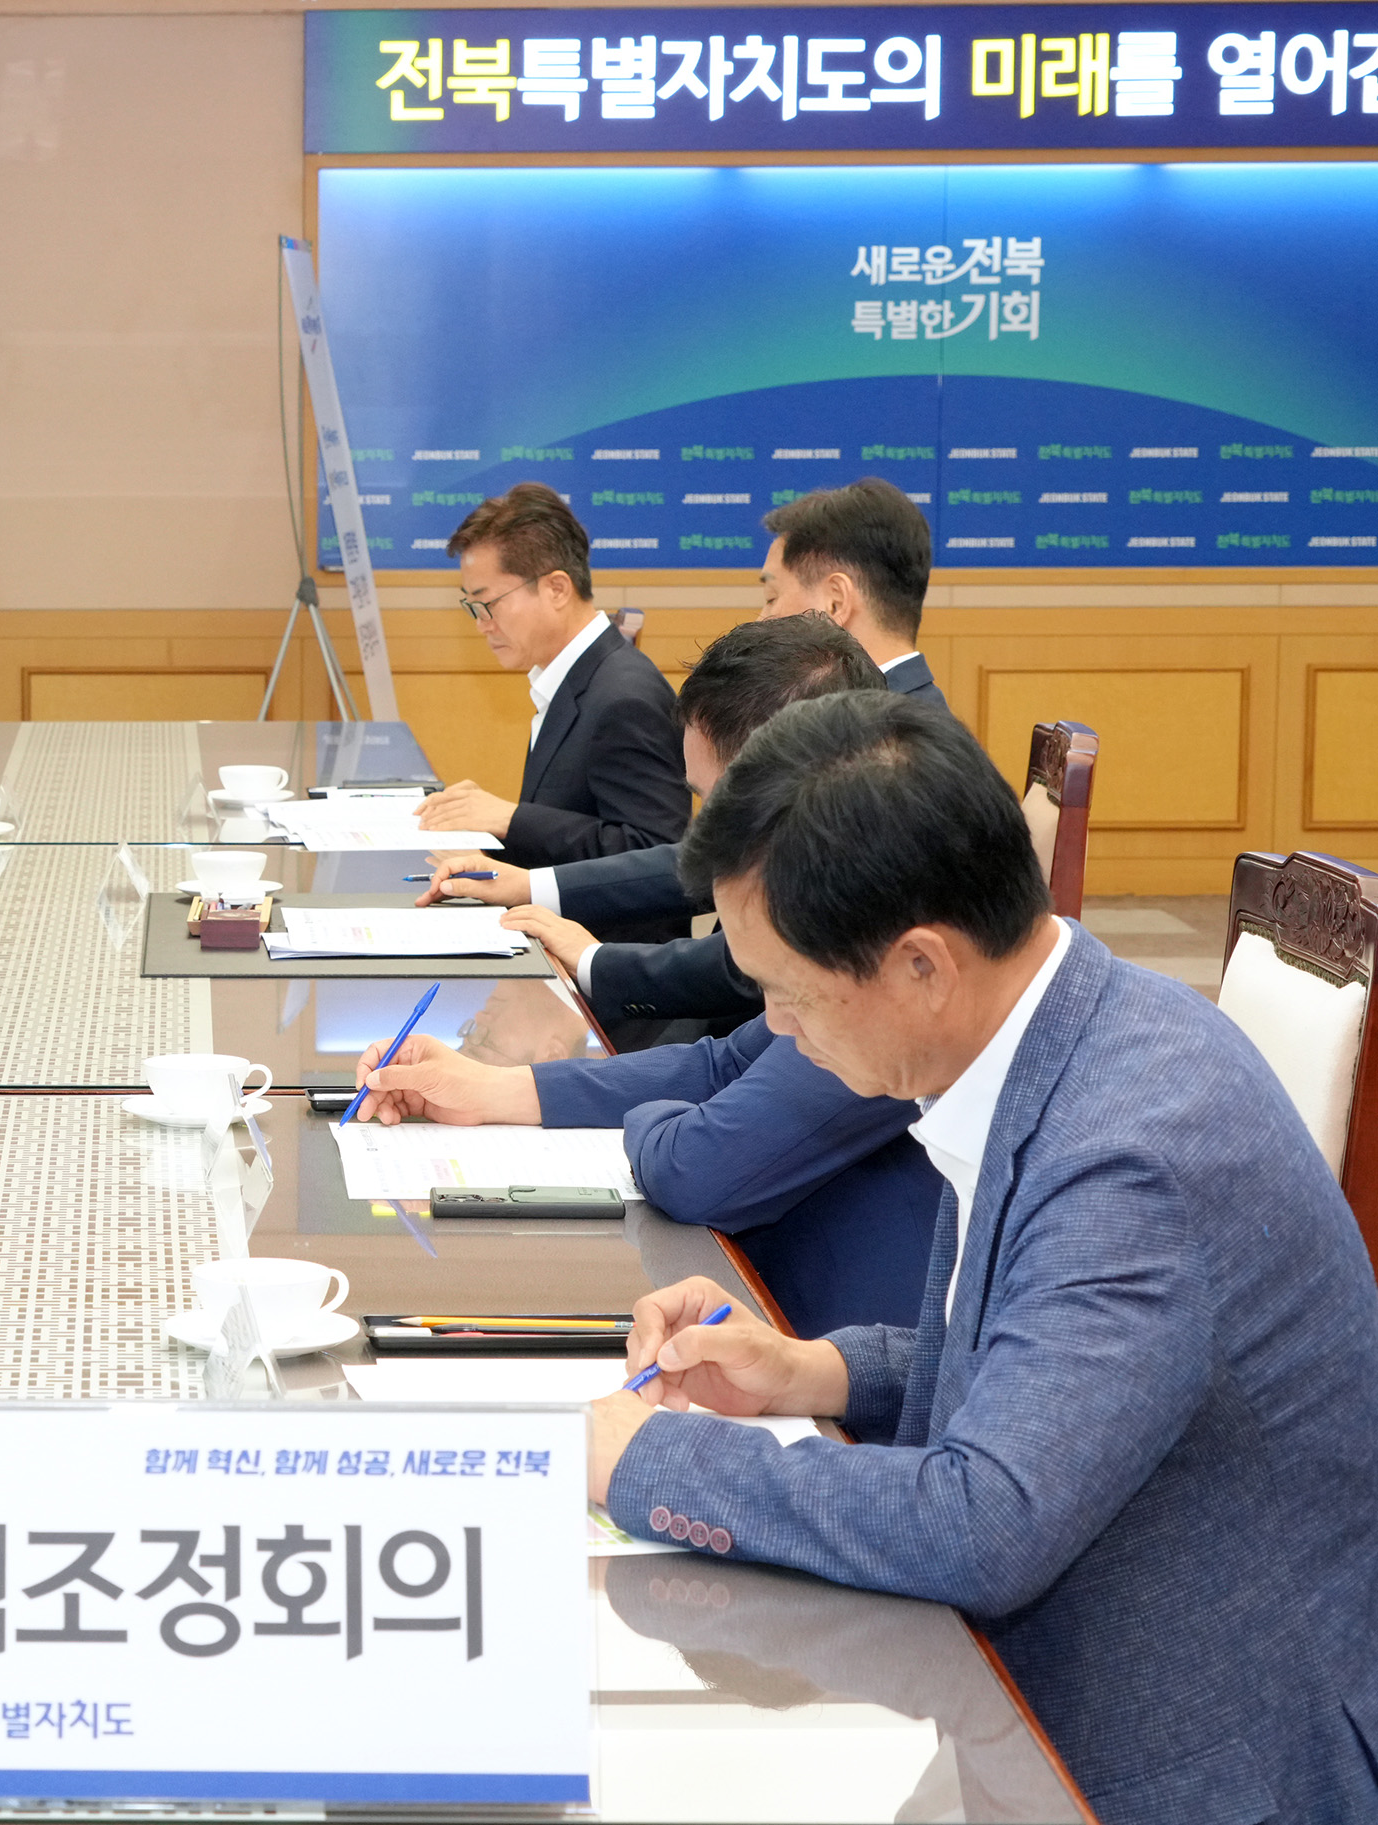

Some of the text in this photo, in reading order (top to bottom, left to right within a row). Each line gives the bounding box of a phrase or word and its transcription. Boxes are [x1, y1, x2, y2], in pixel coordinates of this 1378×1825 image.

[375, 34, 943, 122] 전북특별자치도의
[971, 31, 1183, 120] 미래를
[850, 236, 1045, 286] 새로운 전북
[851, 290, 1040, 341] 특별한 기회
[145, 1448, 551, 1478] 함께 혁신, 함께 성공, 새로운 전북
